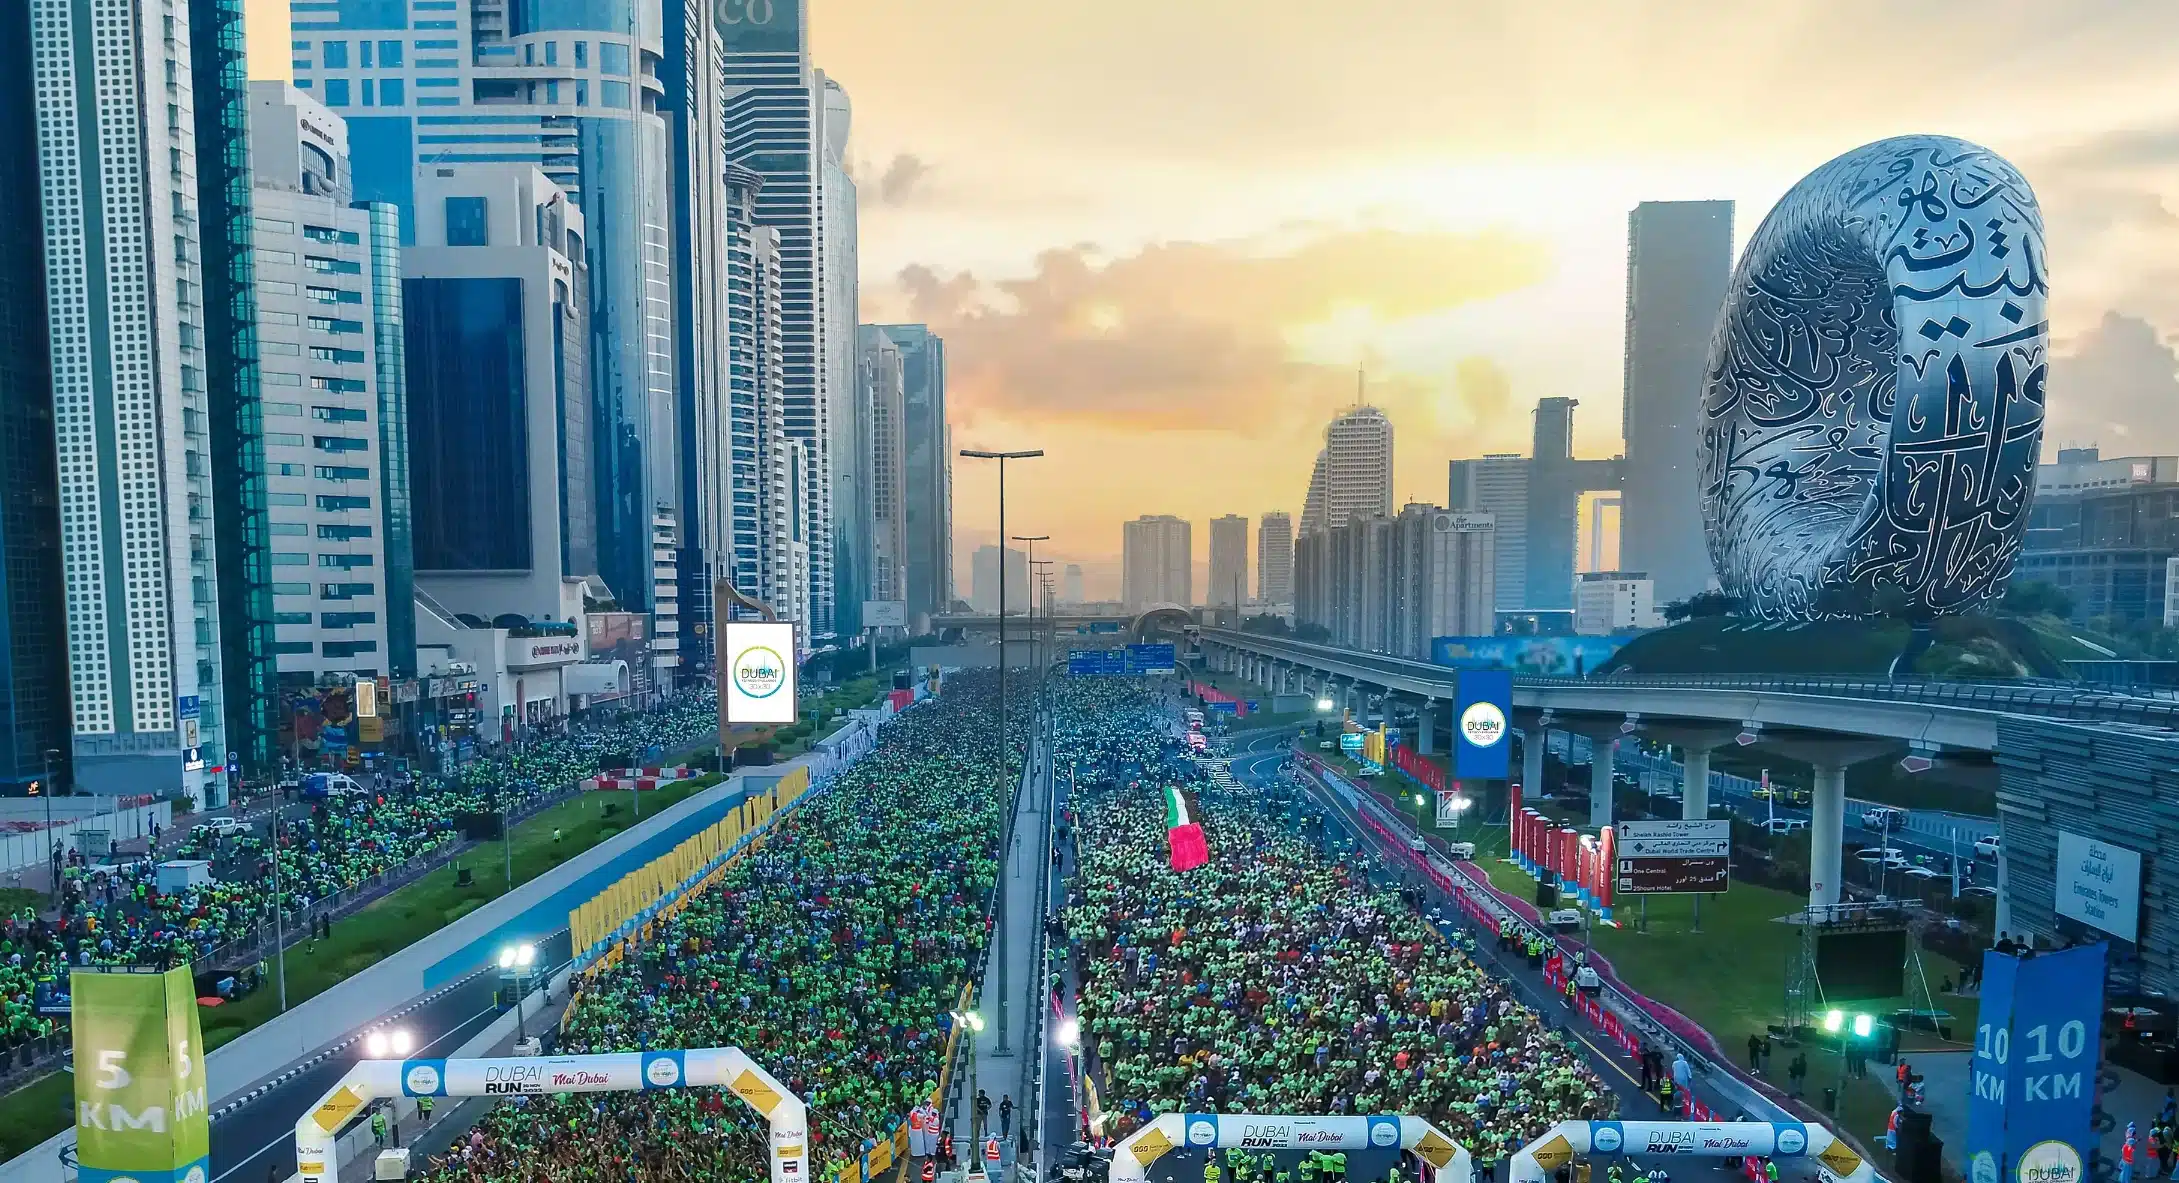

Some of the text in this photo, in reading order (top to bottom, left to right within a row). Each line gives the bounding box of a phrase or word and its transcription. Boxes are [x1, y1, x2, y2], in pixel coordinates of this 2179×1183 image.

[1450, 521, 1494, 531] Apartments
[741, 668, 778, 679] DUBAI
[1467, 721, 1499, 731] DUBAI
[2073, 880, 2098, 901] Emirates
[2084, 901, 2105, 920] Station
[1978, 1023, 2009, 1065] 10
[2025, 1019, 2085, 1063] 10
[180, 1040, 193, 1079] 5
[96, 1050, 131, 1089] 5
[485, 1065, 543, 1082] DUBAI
[553, 1071, 610, 1086] Mai Dubai
[485, 1082, 522, 1094] RUN
[1975, 1071, 2004, 1105] KM
[2025, 1072, 2081, 1102] KM
[174, 1086, 204, 1122] KM
[80, 1100, 167, 1133] KM
[1244, 1125, 1290, 1138] DUBAI
[1298, 1130, 1344, 1143] Mai Dubai
[1649, 1131, 1696, 1144] DUBAI
[1240, 1138, 1273, 1147] RUN
[1646, 1143, 1678, 1153] RUN
[1723, 1137, 1749, 1149] Dubai
[2028, 1167, 2074, 1181] DUBAI
